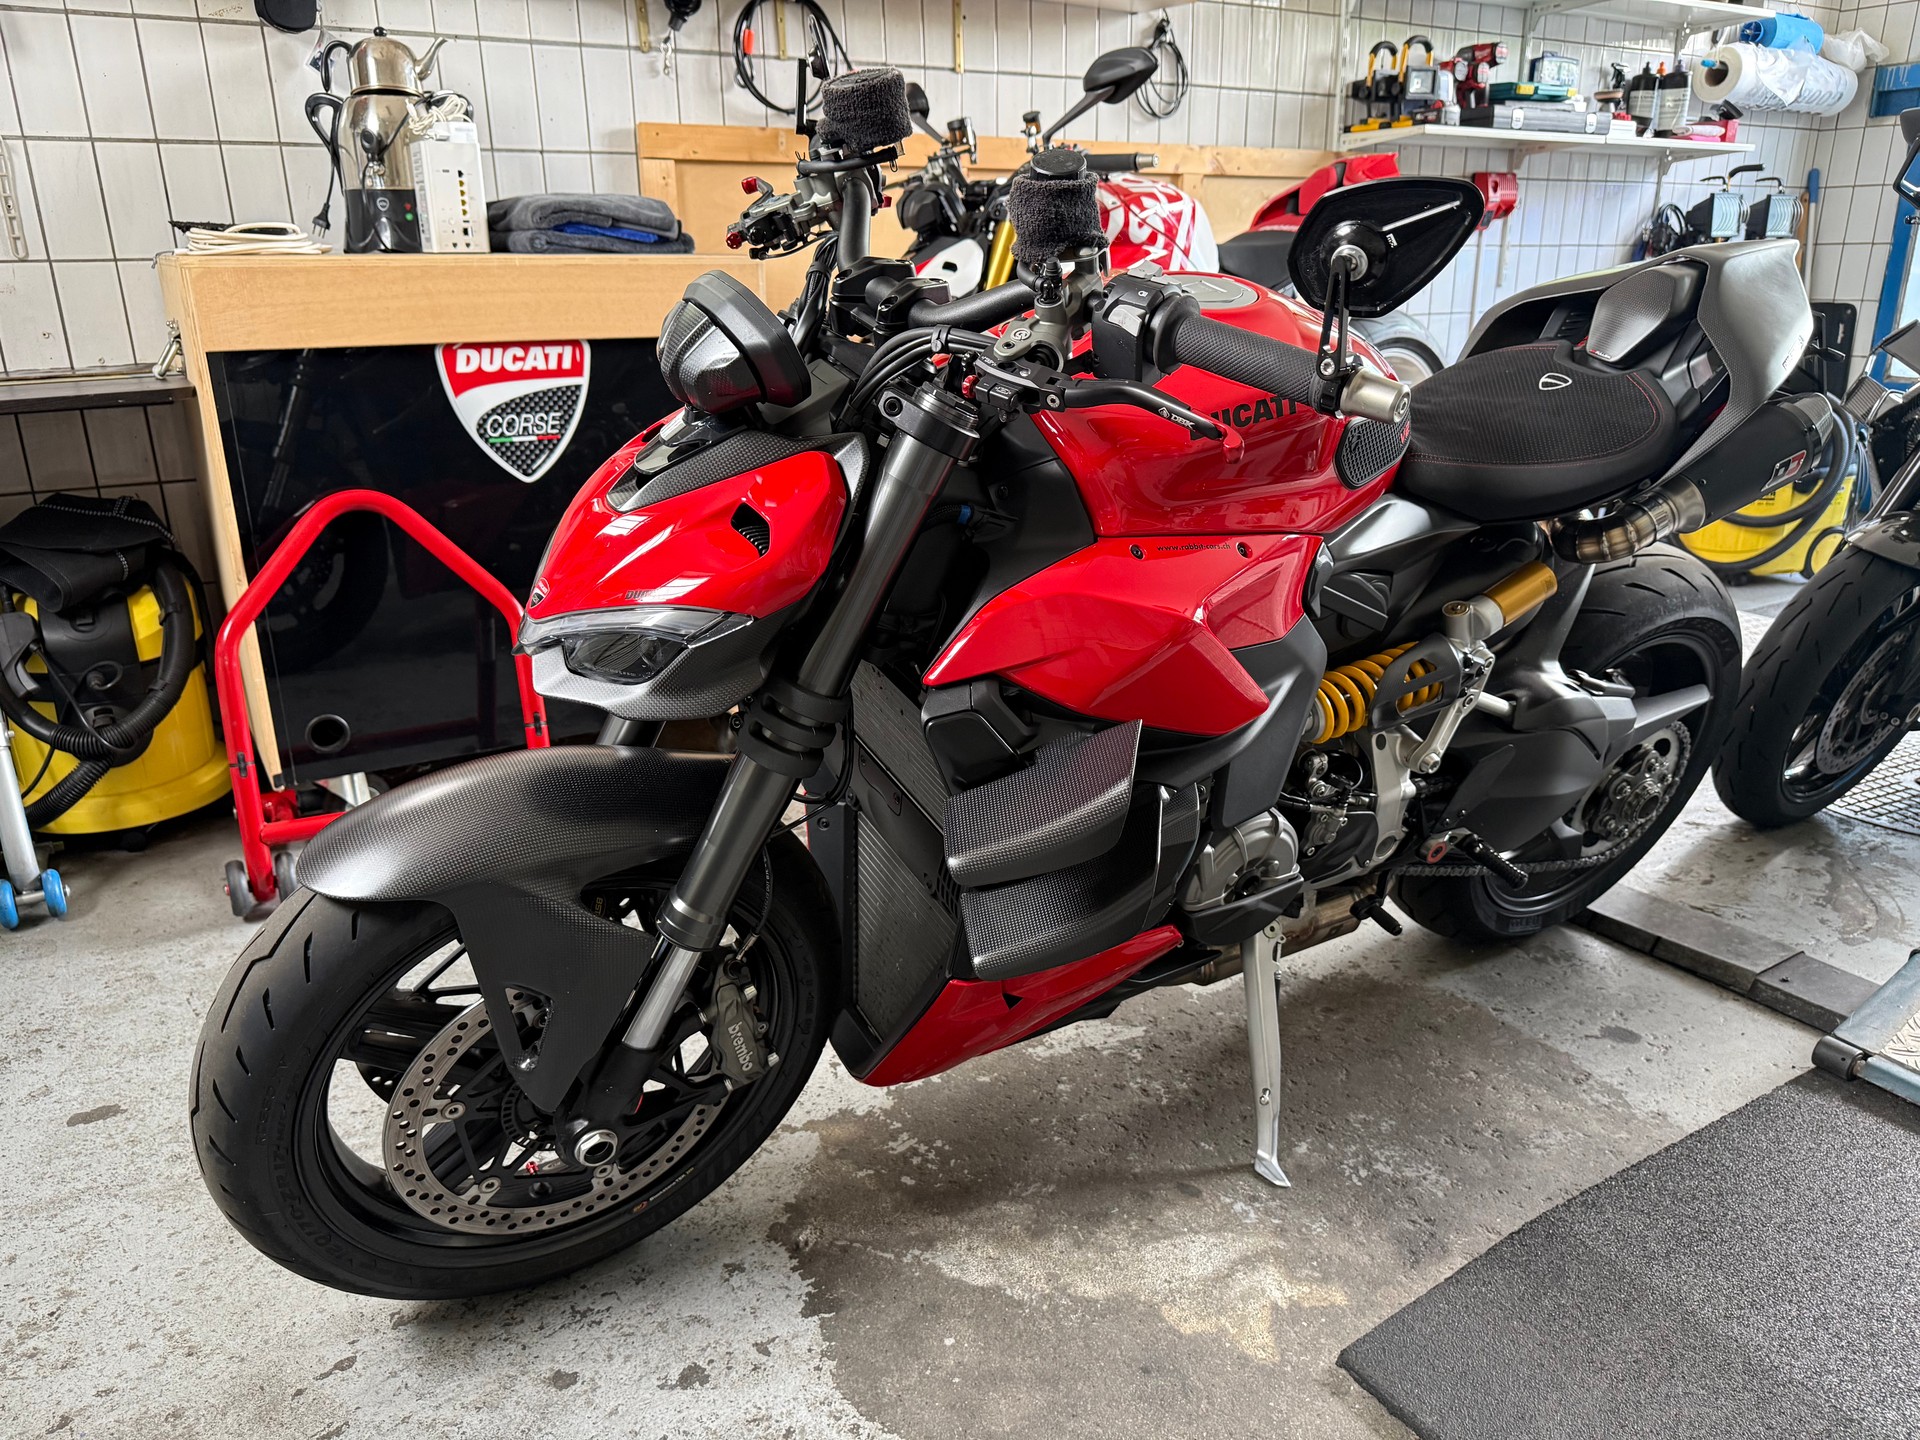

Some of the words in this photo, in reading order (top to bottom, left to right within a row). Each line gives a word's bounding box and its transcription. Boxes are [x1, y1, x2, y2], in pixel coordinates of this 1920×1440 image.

[455, 345, 573, 374] DUCATI
[486, 412, 562, 437] CORSE
[727, 1021, 753, 1072] brembo
